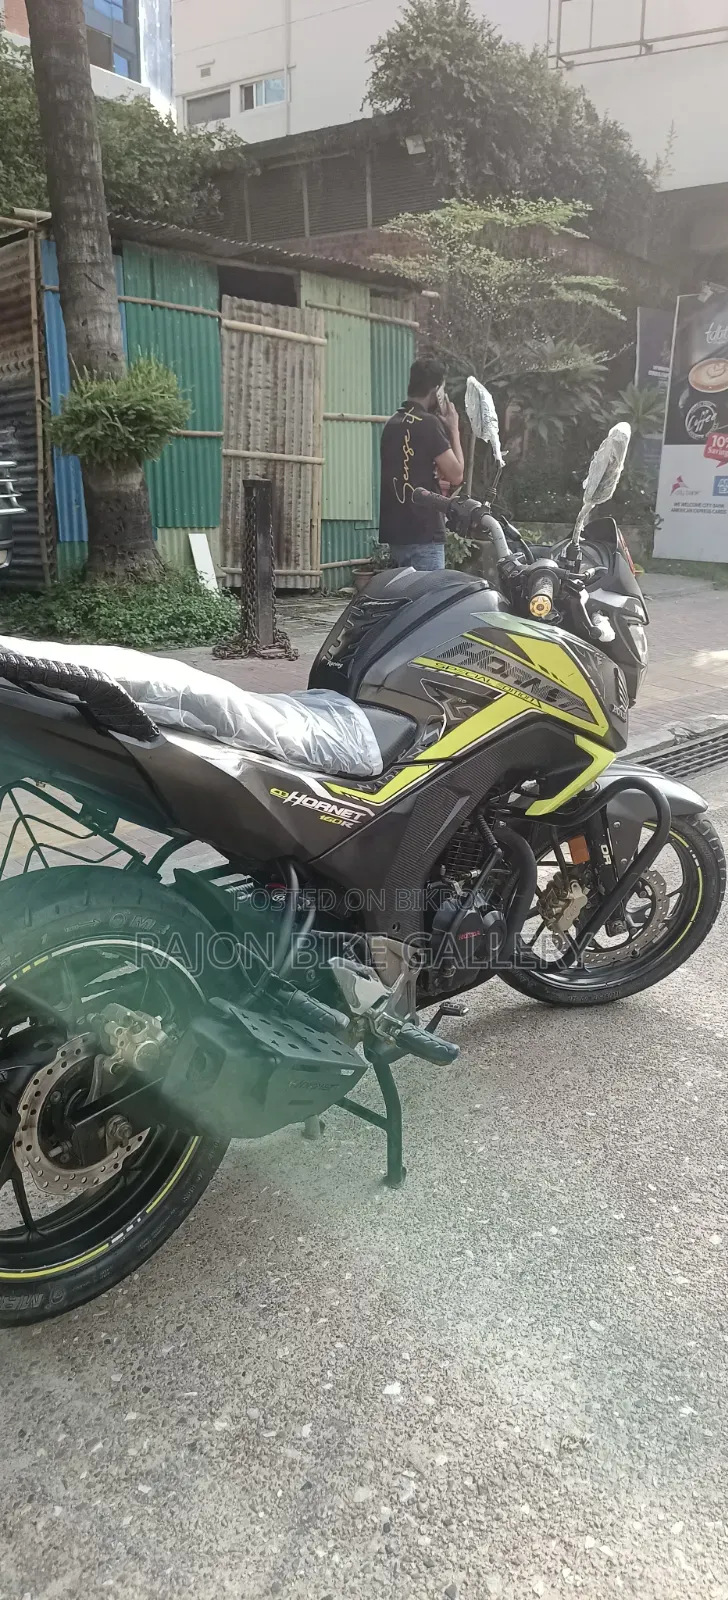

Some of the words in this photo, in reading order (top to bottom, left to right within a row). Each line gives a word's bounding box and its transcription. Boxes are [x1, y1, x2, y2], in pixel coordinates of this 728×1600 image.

[393, 429, 415, 504] Sense
[435, 662, 491, 685] SPECIAL
[283, 791, 367, 821] HORNET
